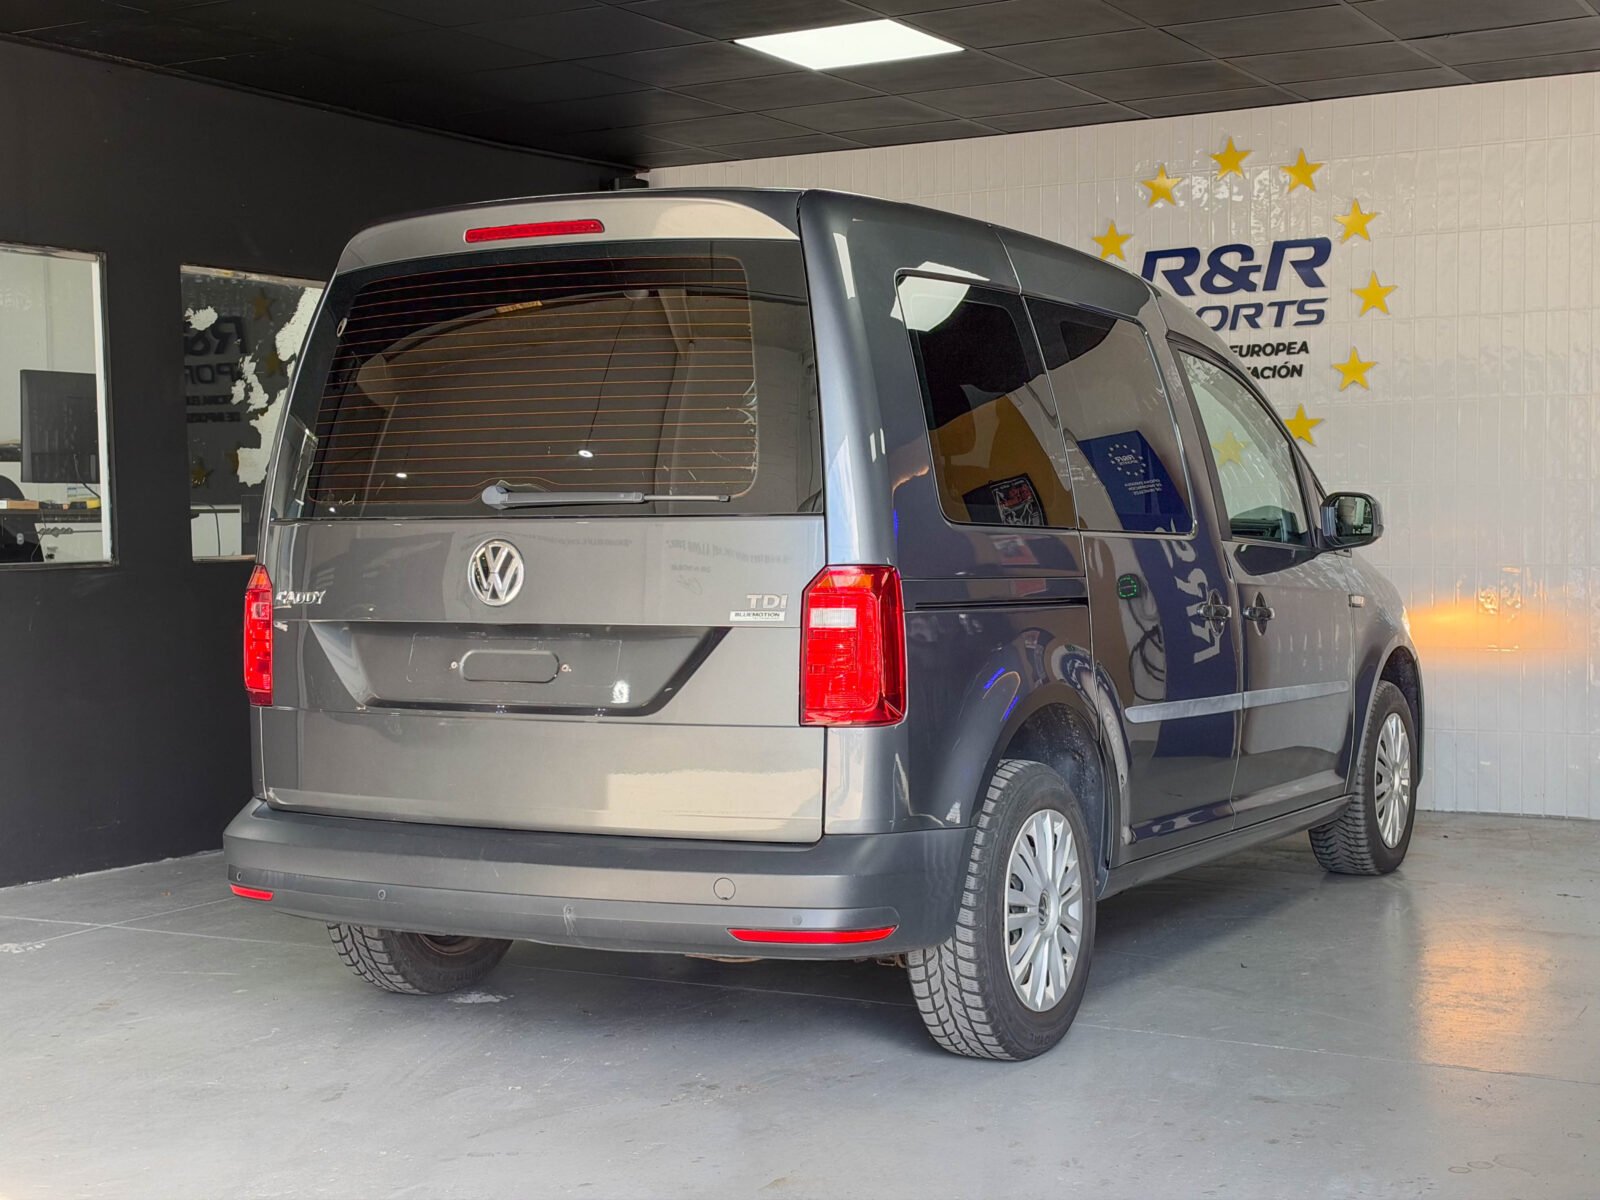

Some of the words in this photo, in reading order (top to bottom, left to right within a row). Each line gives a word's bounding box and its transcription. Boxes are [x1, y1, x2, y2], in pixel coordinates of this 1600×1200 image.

[1141, 237, 1332, 297] R&R
[1195, 297, 1329, 332] ORTS
[1246, 361, 1304, 379] ACIÓN
[746, 594, 788, 609] TDI
